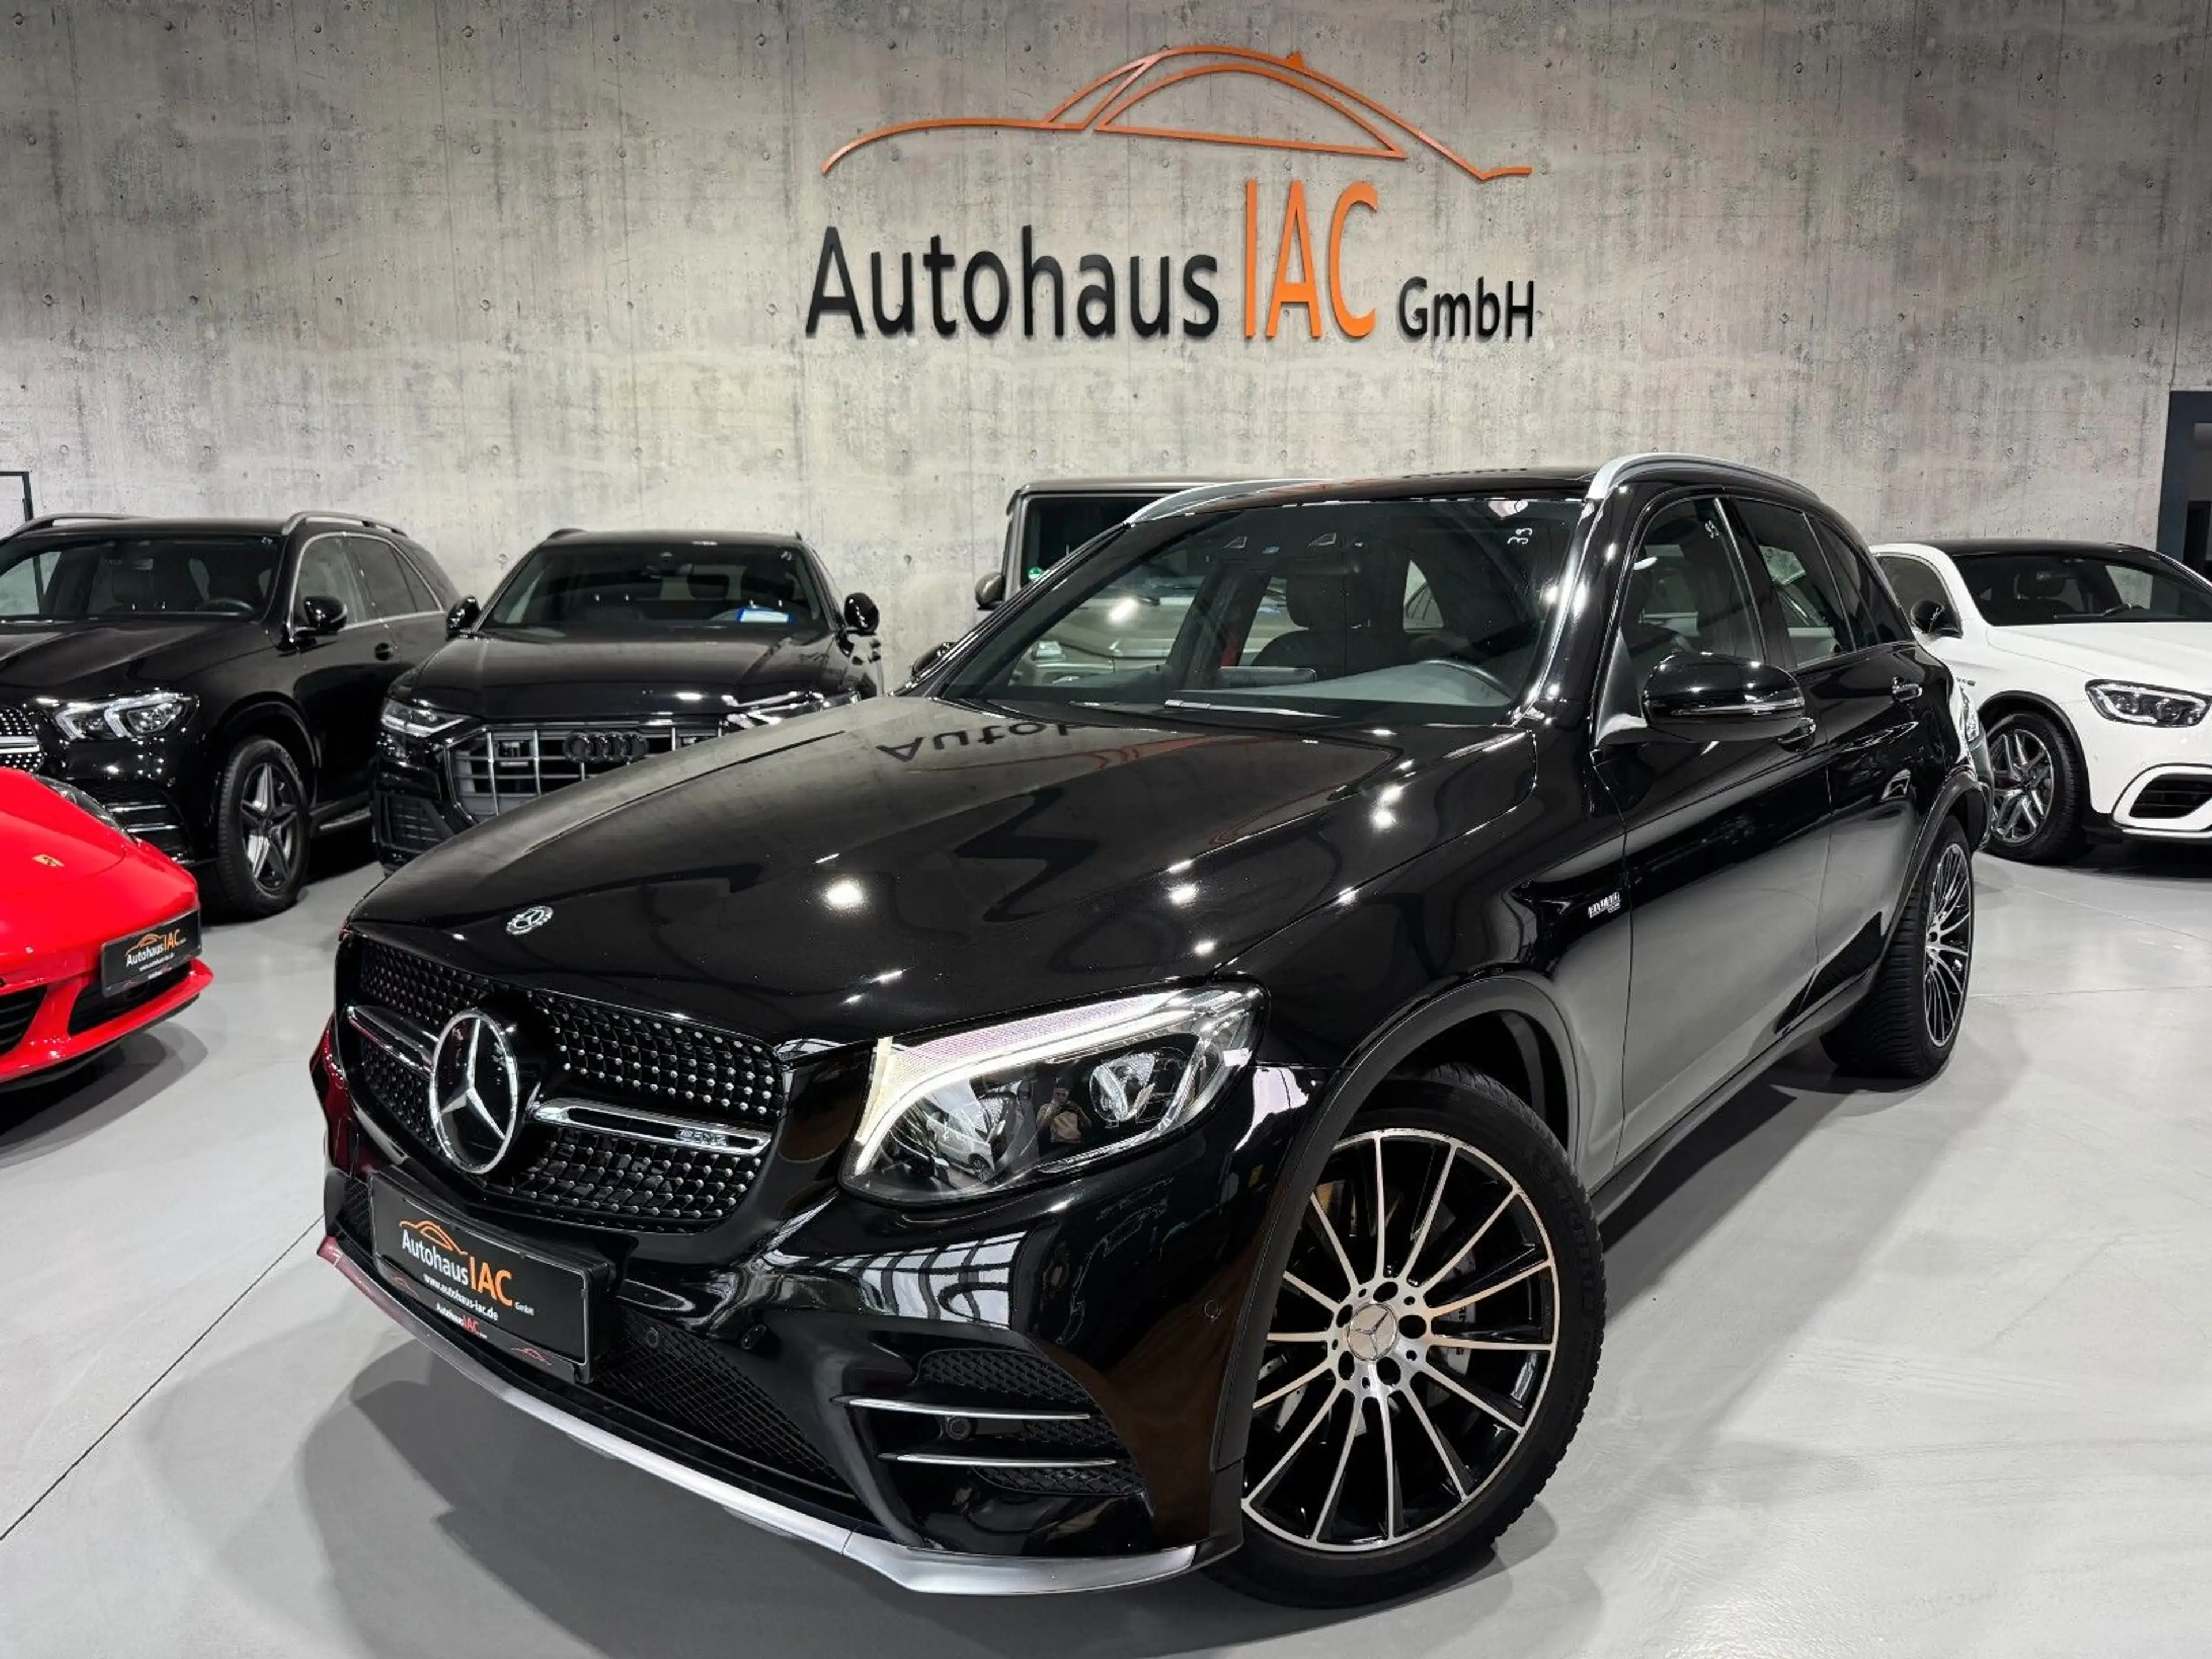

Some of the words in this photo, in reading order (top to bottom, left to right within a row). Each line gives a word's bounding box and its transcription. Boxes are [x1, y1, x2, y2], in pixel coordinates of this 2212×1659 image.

[805, 225, 1219, 339] Autohaus
[1243, 180, 1378, 340] IAC
[1398, 276, 1536, 340] GmbH
[126, 943, 164, 967] Autohaus
[164, 929, 181, 952] IAC
[402, 1229, 469, 1286] Autohaus
[469, 1256, 513, 1307] IAC
